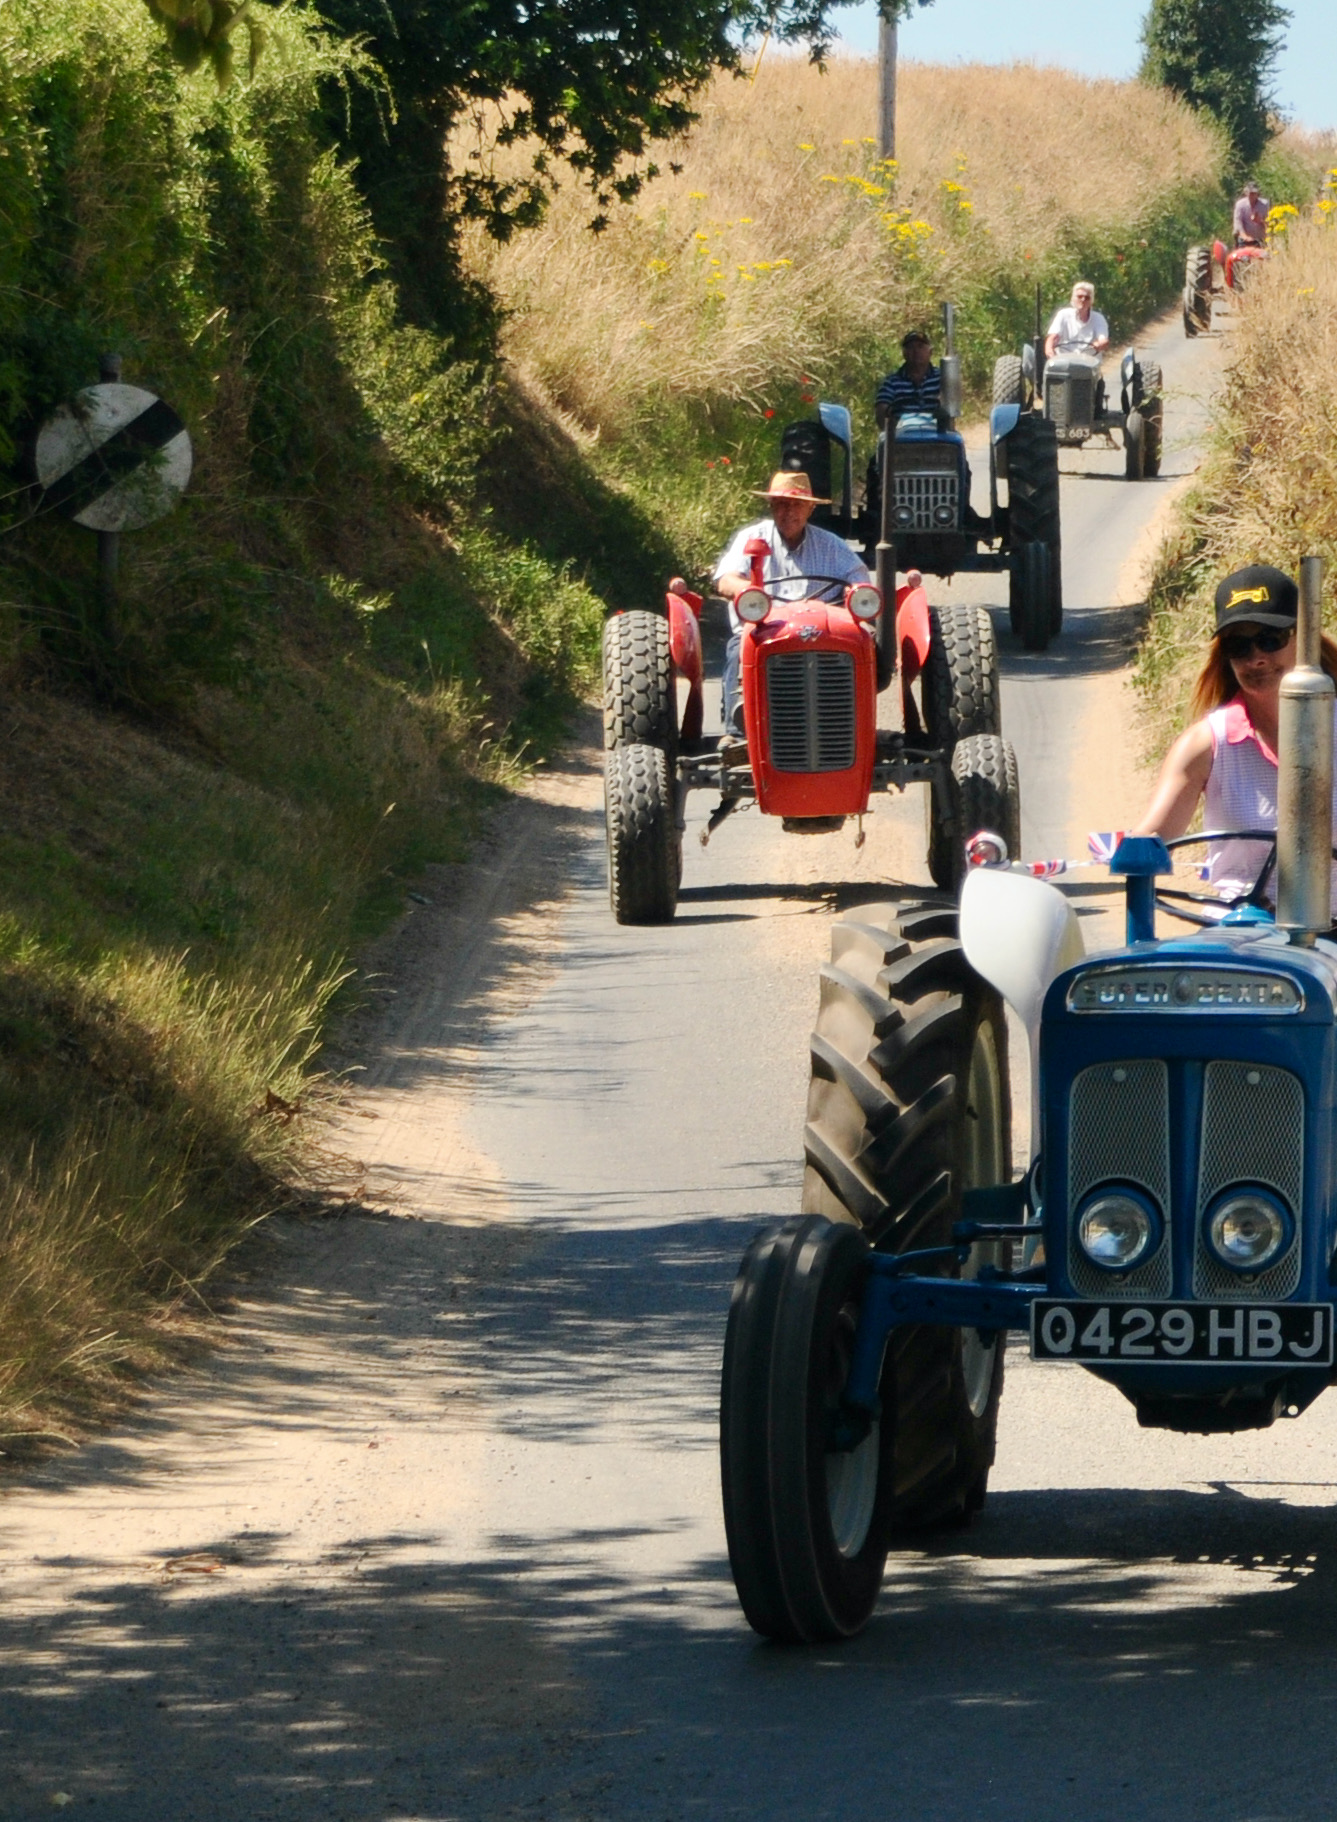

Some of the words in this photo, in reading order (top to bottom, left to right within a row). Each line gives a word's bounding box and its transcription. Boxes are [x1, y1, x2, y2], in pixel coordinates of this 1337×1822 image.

[1069, 428, 1090, 438] 683
[1083, 982, 1168, 1003] SUPER
[1198, 982, 1285, 1003] DEXTA
[1041, 1306, 1194, 1355] Q429
[1210, 1308, 1323, 1357] HBJ
